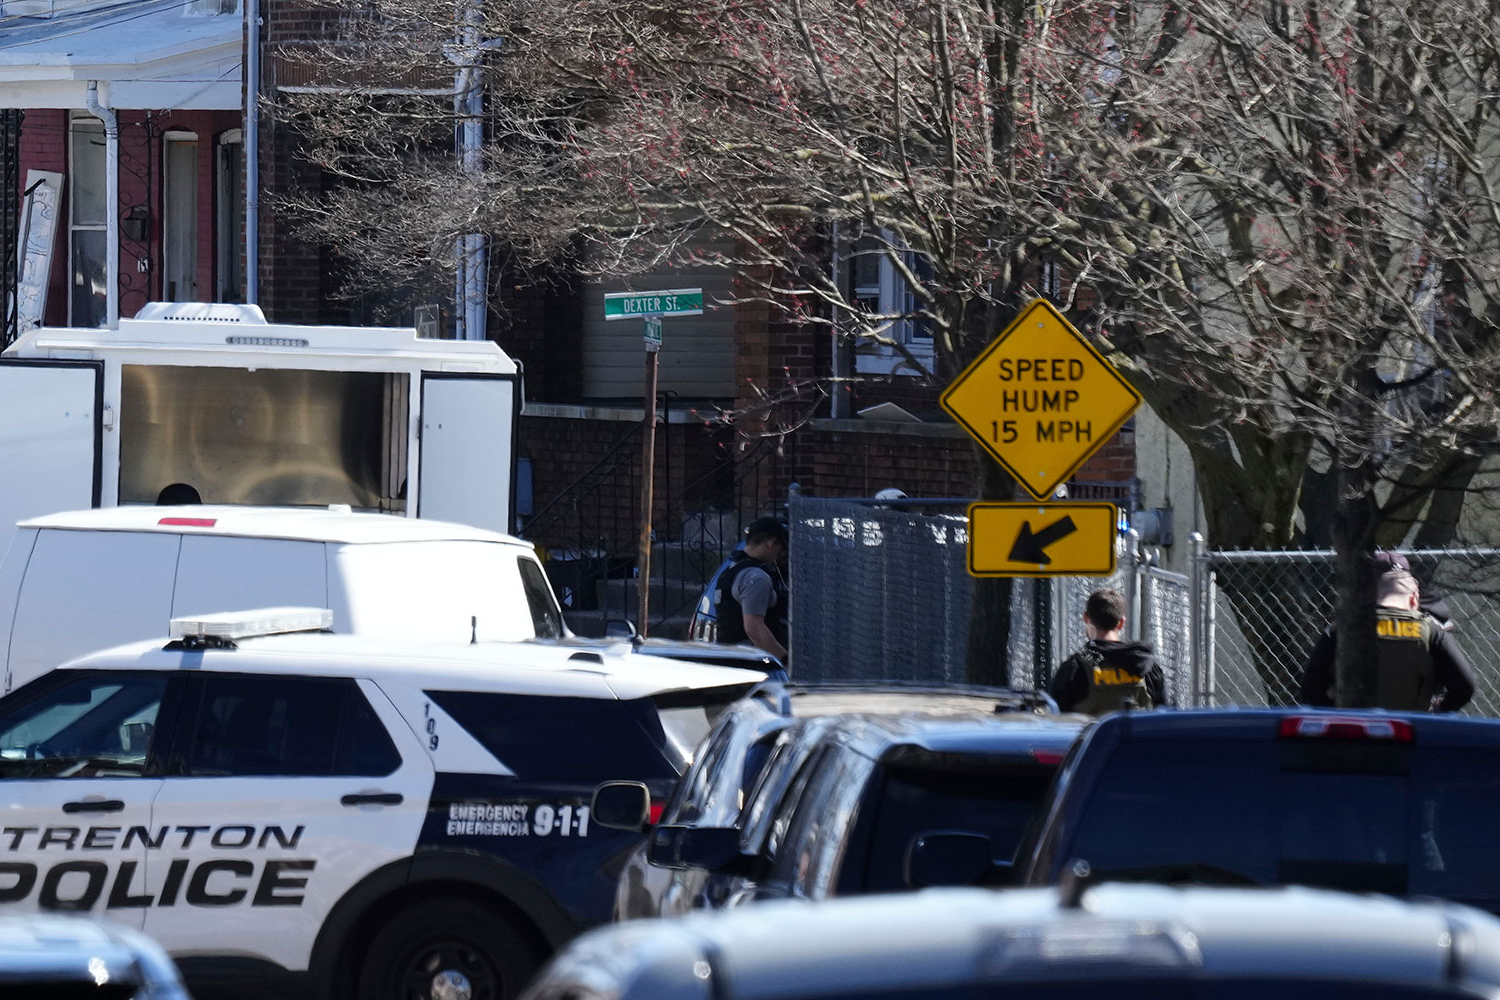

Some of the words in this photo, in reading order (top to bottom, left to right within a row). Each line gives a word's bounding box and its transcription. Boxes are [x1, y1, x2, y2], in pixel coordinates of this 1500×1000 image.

[624, 297, 661, 313] DEXTER
[666, 296, 681, 311] ST.
[999, 359, 1084, 381] SPEED
[1002, 390, 1080, 412] HUMP
[992, 421, 1018, 443] 15
[1036, 421, 1092, 443] MPH
[1376, 618, 1422, 638] OLICE
[449, 804, 528, 820] EMERGENCY
[3, 825, 305, 851] TRENTON
[447, 820, 529, 836] EMERGENCIA
